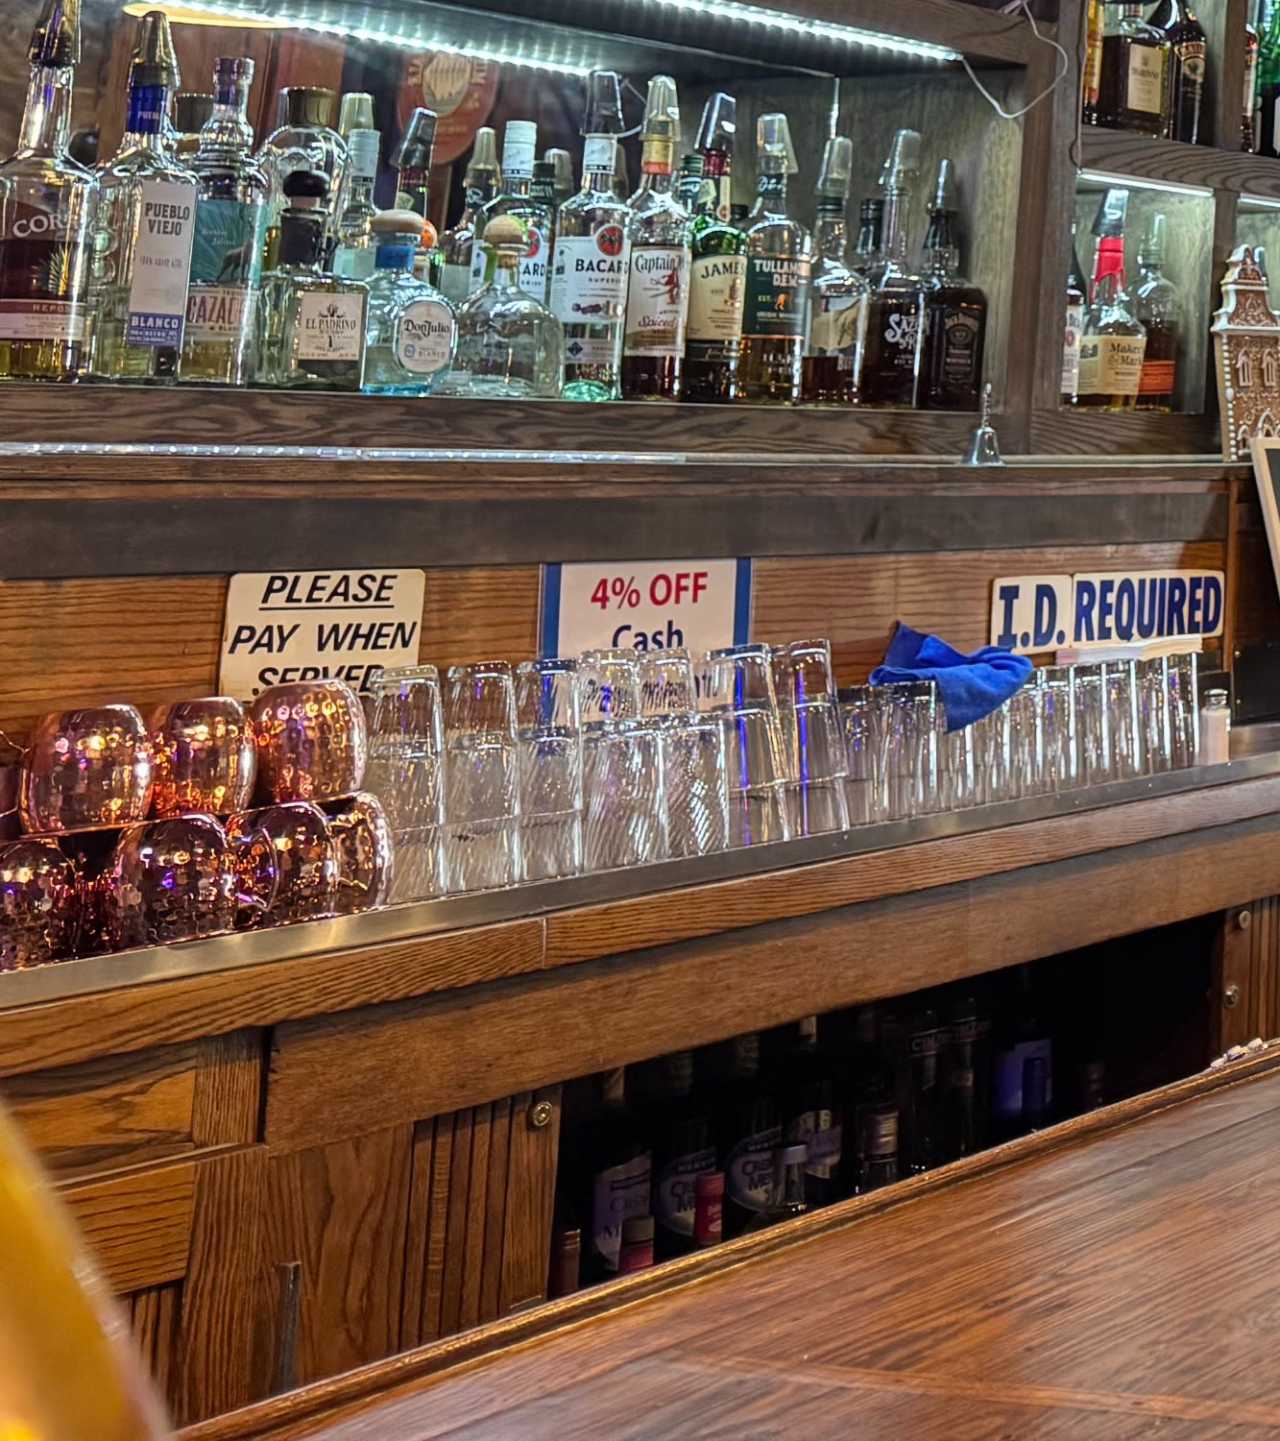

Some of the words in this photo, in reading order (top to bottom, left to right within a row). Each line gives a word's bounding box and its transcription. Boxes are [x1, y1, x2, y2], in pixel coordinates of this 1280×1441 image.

[145, 202, 190, 221] PUEBLO
[148, 219, 183, 237] VIEJO
[131, 314, 179, 329] BLANCO
[260, 573, 397, 605] PLEASE
[590, 577, 641, 610] 4%
[648, 571, 709, 605] OFF
[996, 582, 1066, 649] I.D.
[1072, 573, 1222, 642] REQUIRED
[228, 623, 300, 654] PAY
[315, 620, 418, 652] WHEN
[611, 620, 685, 651] Cash
